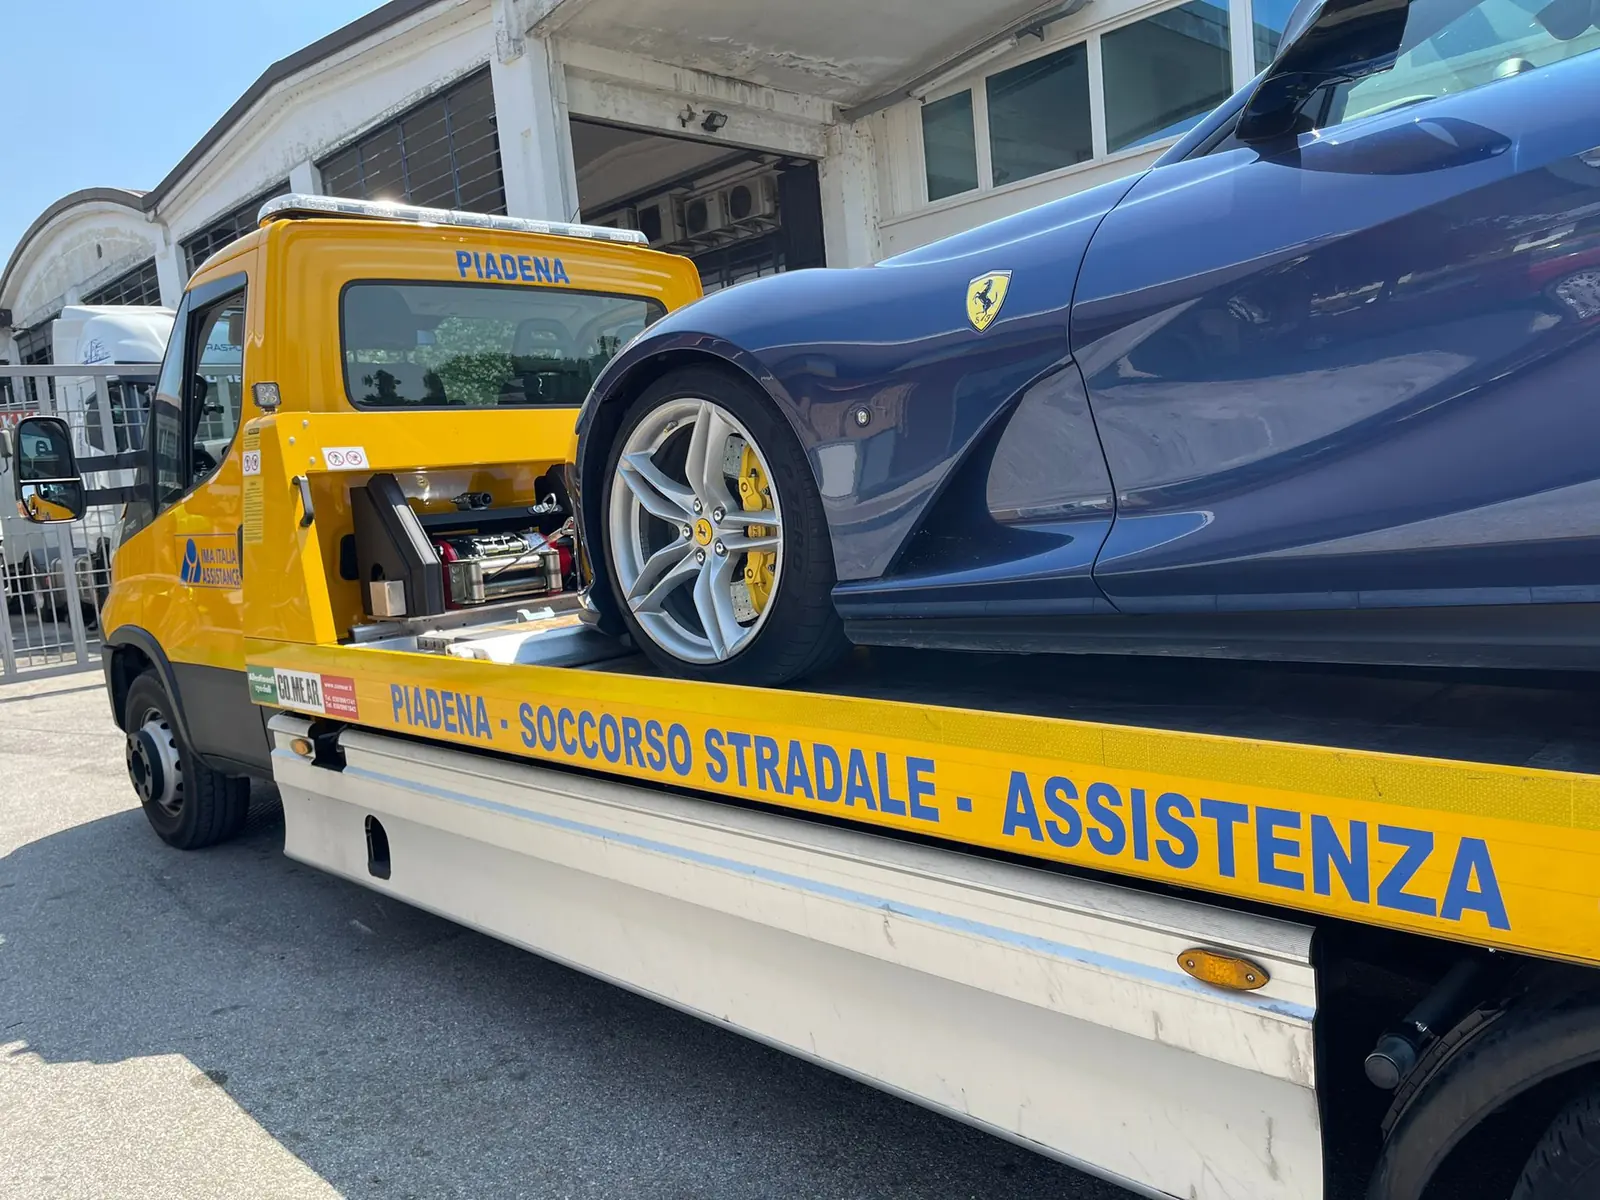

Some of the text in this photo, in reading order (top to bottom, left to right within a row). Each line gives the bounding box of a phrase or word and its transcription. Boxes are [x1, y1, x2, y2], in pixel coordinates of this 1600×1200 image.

[456, 250, 570, 284] PIADENA
[201, 548, 239, 565] IMA ITALIA
[202, 567, 240, 585] ASSISTANCE
[390, 683, 493, 740] PIADENA
[519, 702, 692, 777] SOCCORSO
[704, 728, 940, 822] STRADALE
[1001, 770, 1511, 931] ASSISTENZA
